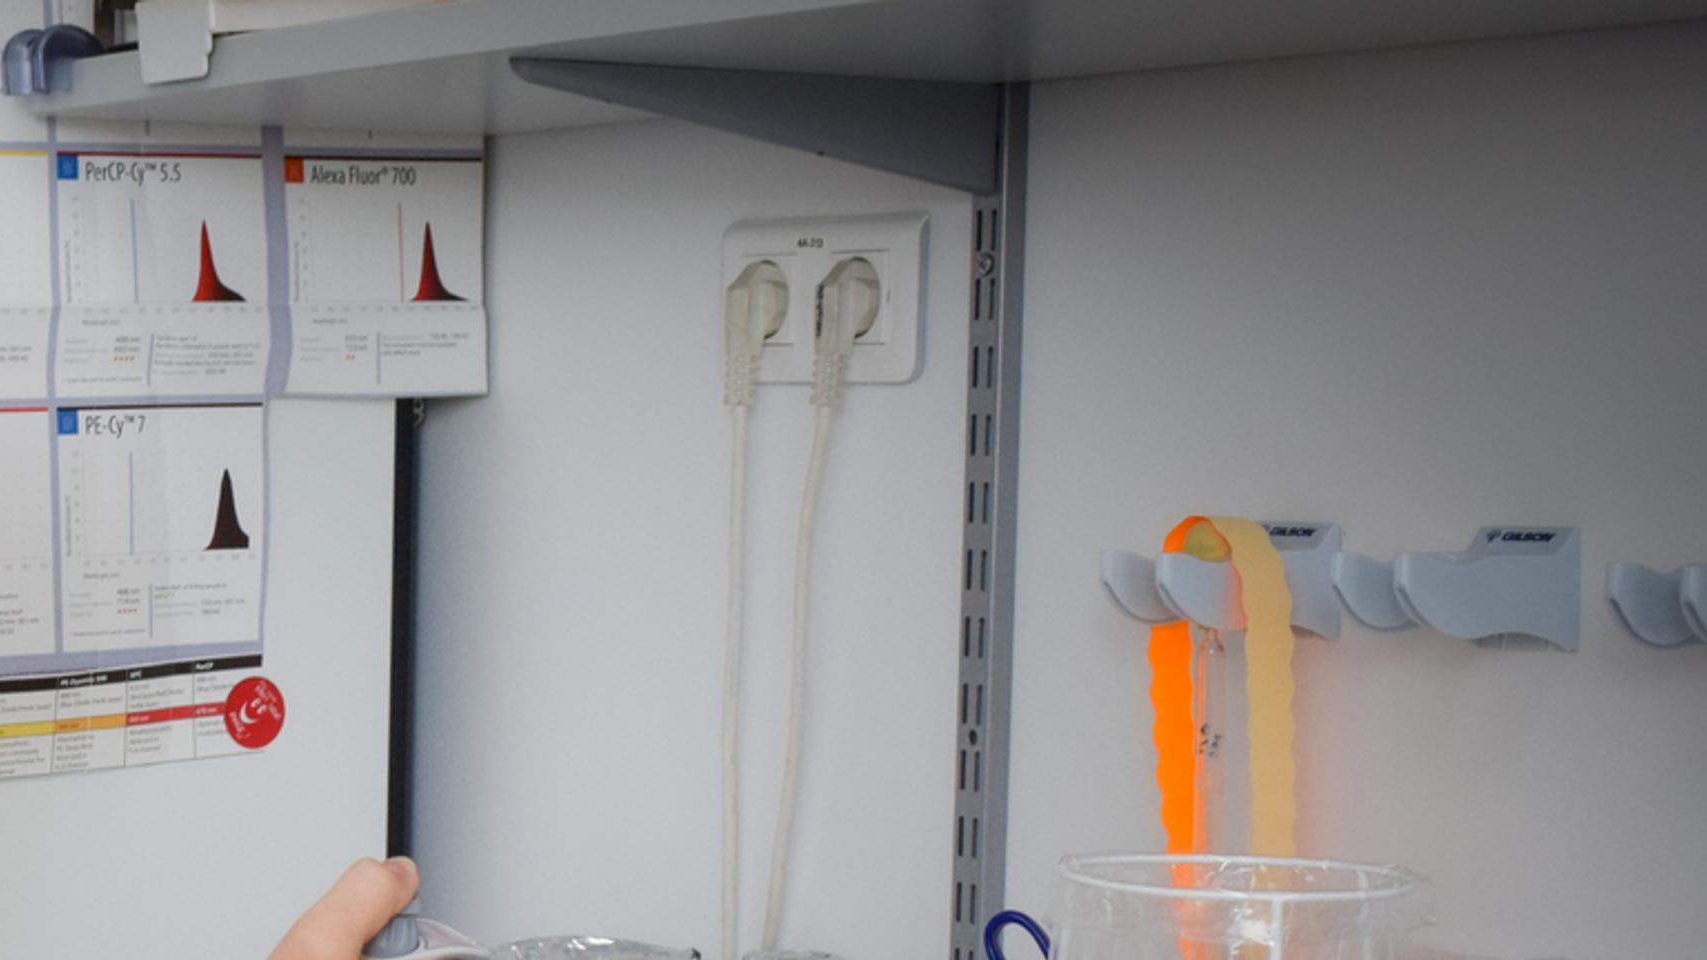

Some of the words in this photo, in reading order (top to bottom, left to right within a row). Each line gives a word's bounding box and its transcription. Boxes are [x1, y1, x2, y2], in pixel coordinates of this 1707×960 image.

[160, 162, 182, 182] 5.5
[310, 166, 346, 185] Alexa
[391, 166, 416, 186] 700
[137, 416, 146, 433] 7
[1270, 527, 1318, 537] GILSON
[1501, 531, 1556, 542] GILSON
